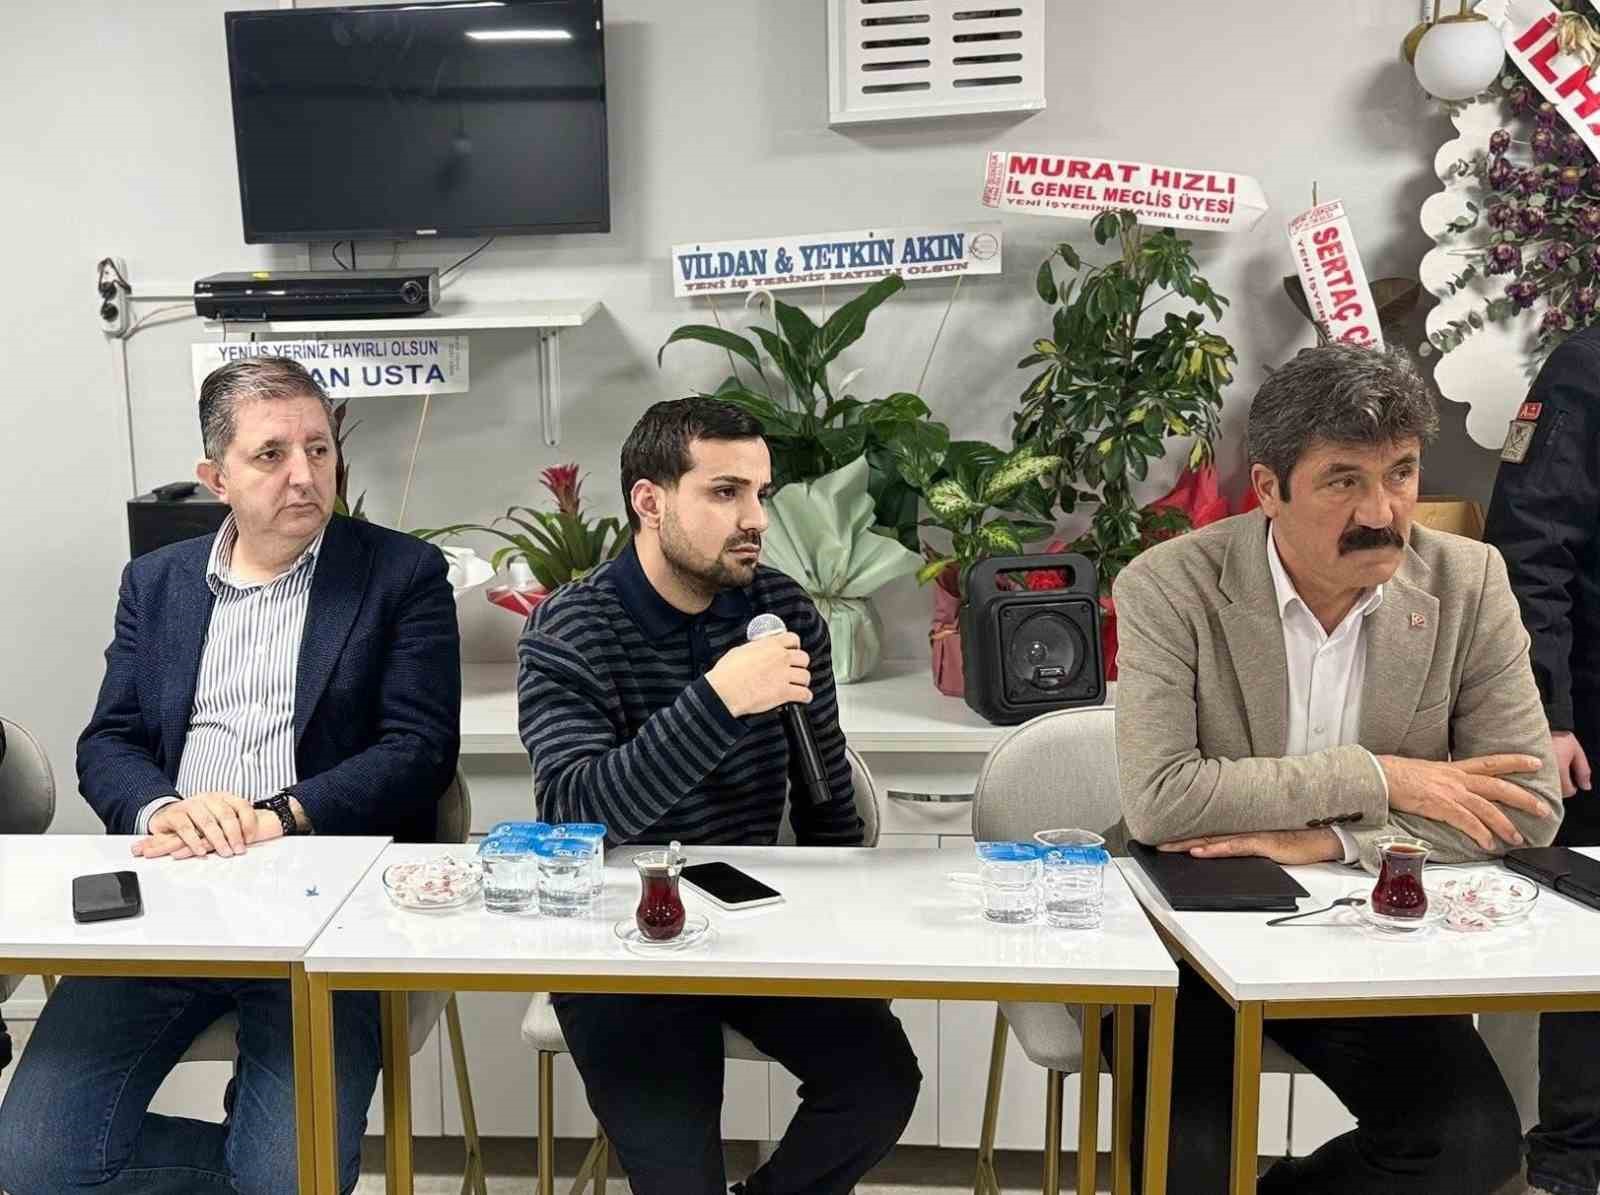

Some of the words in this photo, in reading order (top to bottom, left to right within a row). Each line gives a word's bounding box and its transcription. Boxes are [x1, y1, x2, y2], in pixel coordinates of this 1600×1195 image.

[1009, 156, 1141, 183] MURAT
[1151, 168, 1236, 195] HIZLI
[1006, 177, 1024, 195] İL
[1031, 182, 1097, 201] GENEL
[1103, 187, 1172, 209] MECLİS
[1178, 193, 1234, 214] ÜYESİ
[1184, 213, 1231, 225] OLSUN
[678, 245, 768, 280] VİLDAN
[775, 247, 794, 274] &
[799, 231, 895, 271] YETKİN
[900, 232, 965, 264] AKIN
[829, 267, 902, 281] HAYIRLI
[907, 262, 969, 275] OLSUN
[1312, 226, 1363, 322] SERTAÇ
[332, 341, 388, 359] HAYIRLI
[391, 339, 439, 357] OLSUN
[362, 364, 446, 387] USTA
